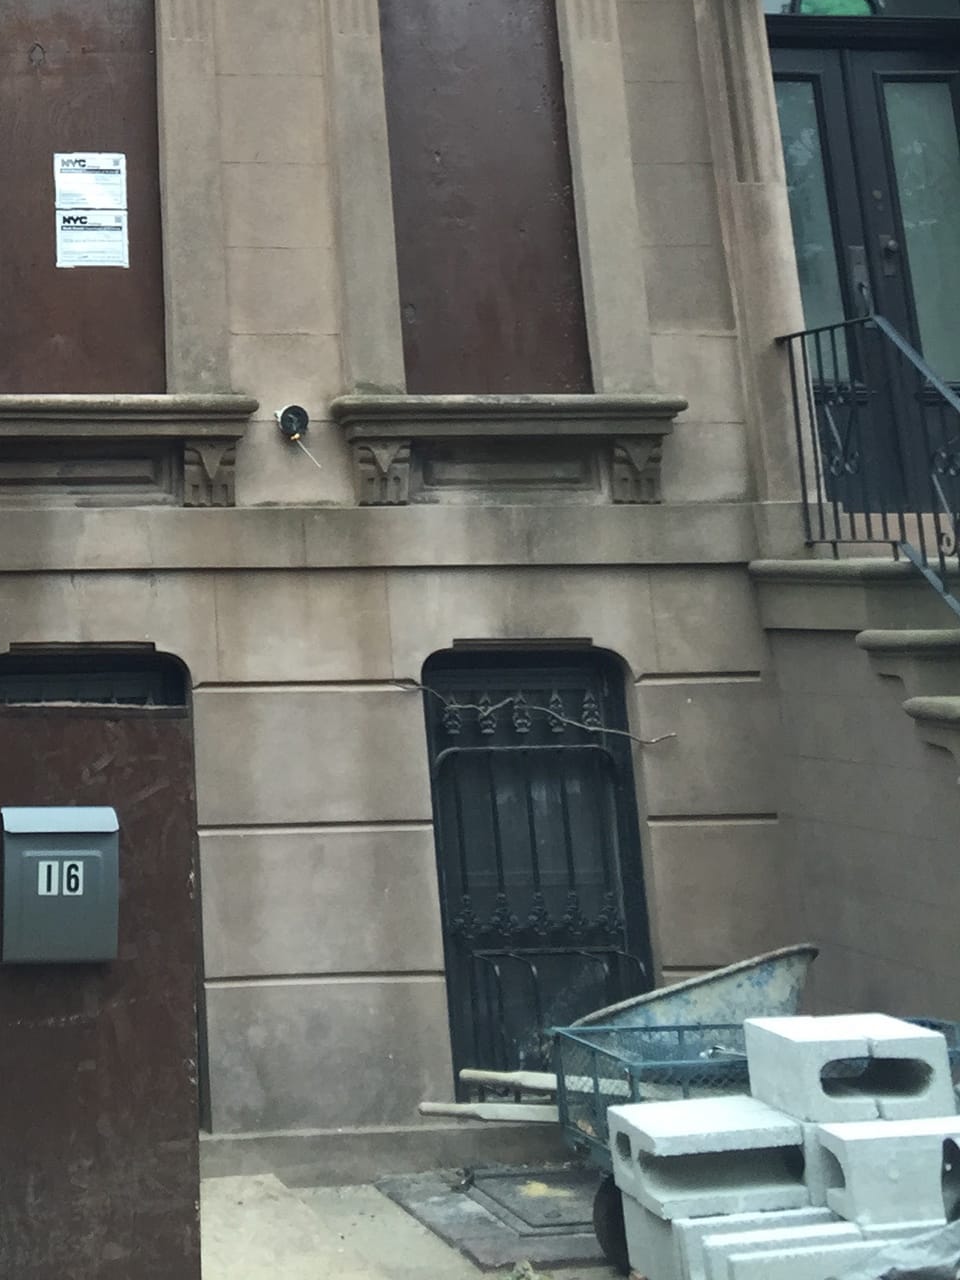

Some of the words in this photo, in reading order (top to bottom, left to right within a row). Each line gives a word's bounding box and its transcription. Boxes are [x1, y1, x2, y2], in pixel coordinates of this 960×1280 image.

[61, 158, 86, 168] NYC
[62, 216, 88, 225] NYC
[46, 863, 80, 893] 16
